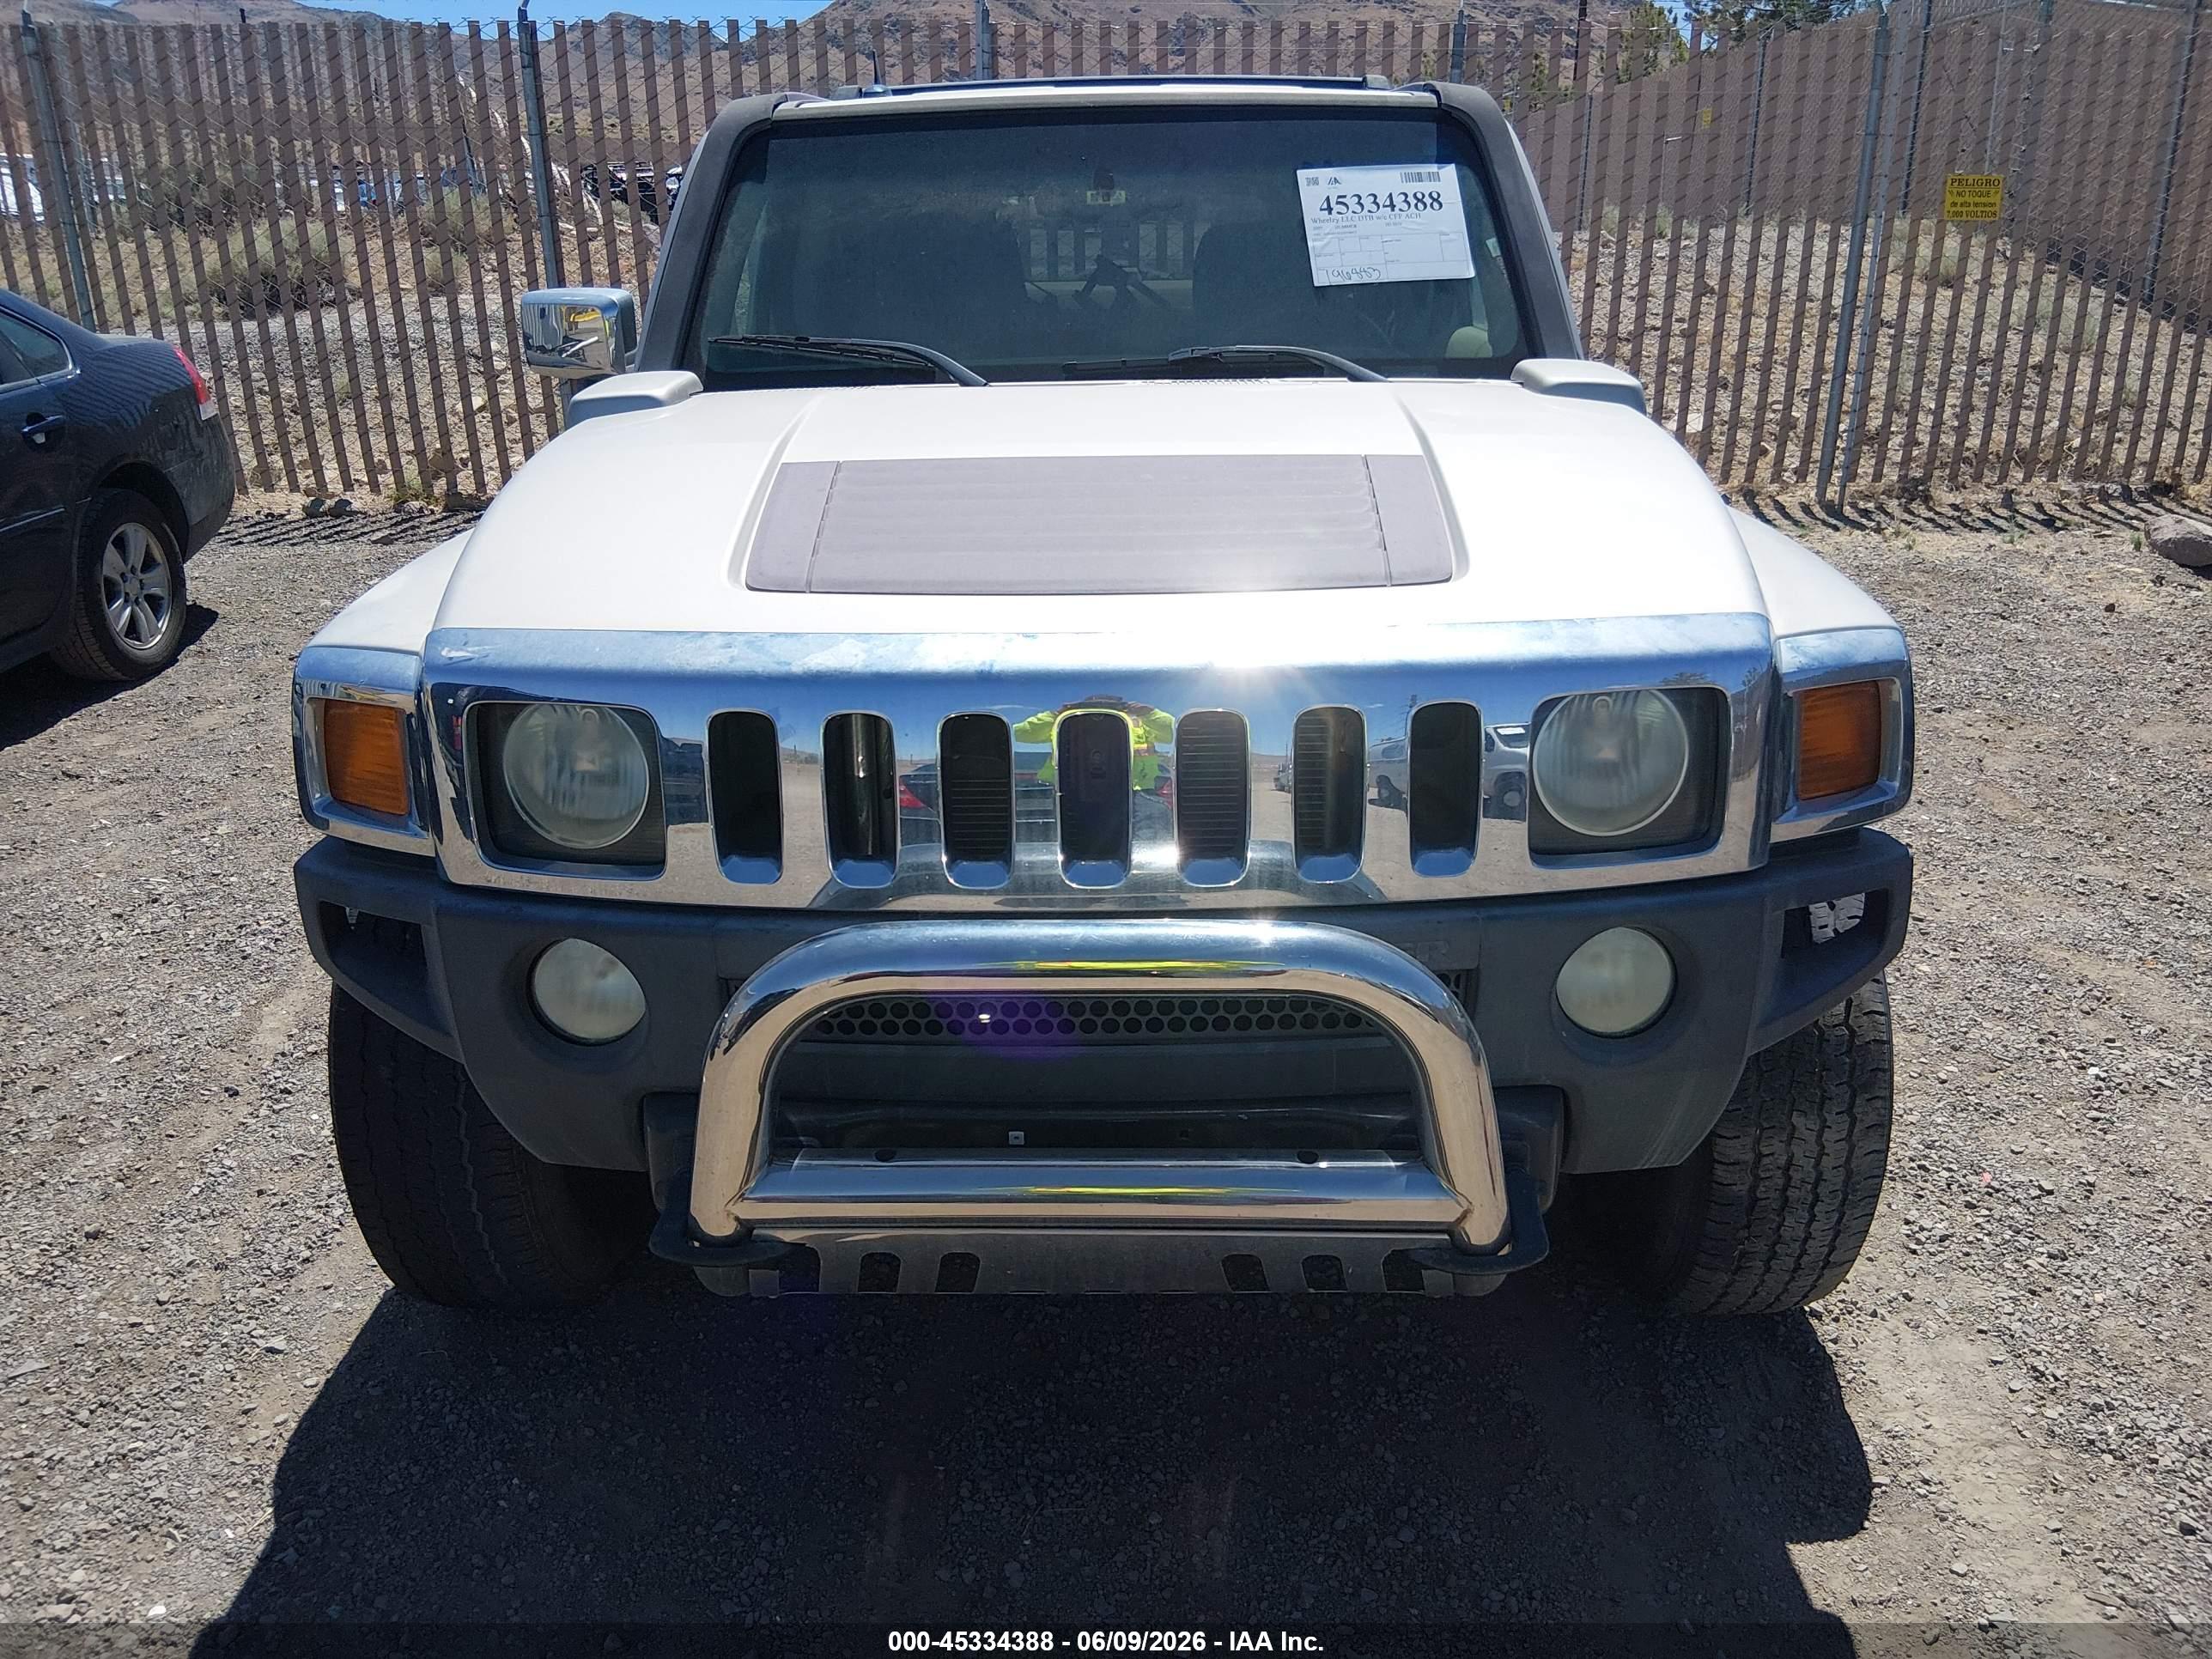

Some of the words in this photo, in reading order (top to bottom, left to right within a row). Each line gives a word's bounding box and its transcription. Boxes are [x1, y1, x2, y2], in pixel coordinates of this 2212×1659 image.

[1950, 178, 2001, 187] PELIGRO
[1955, 190, 1966, 198] NO
[1968, 190, 1992, 198] TOQUE
[1319, 191, 1443, 216] 45334388
[1946, 210, 1964, 219] 7,000
[1965, 210, 1997, 218] VOLTIOS
